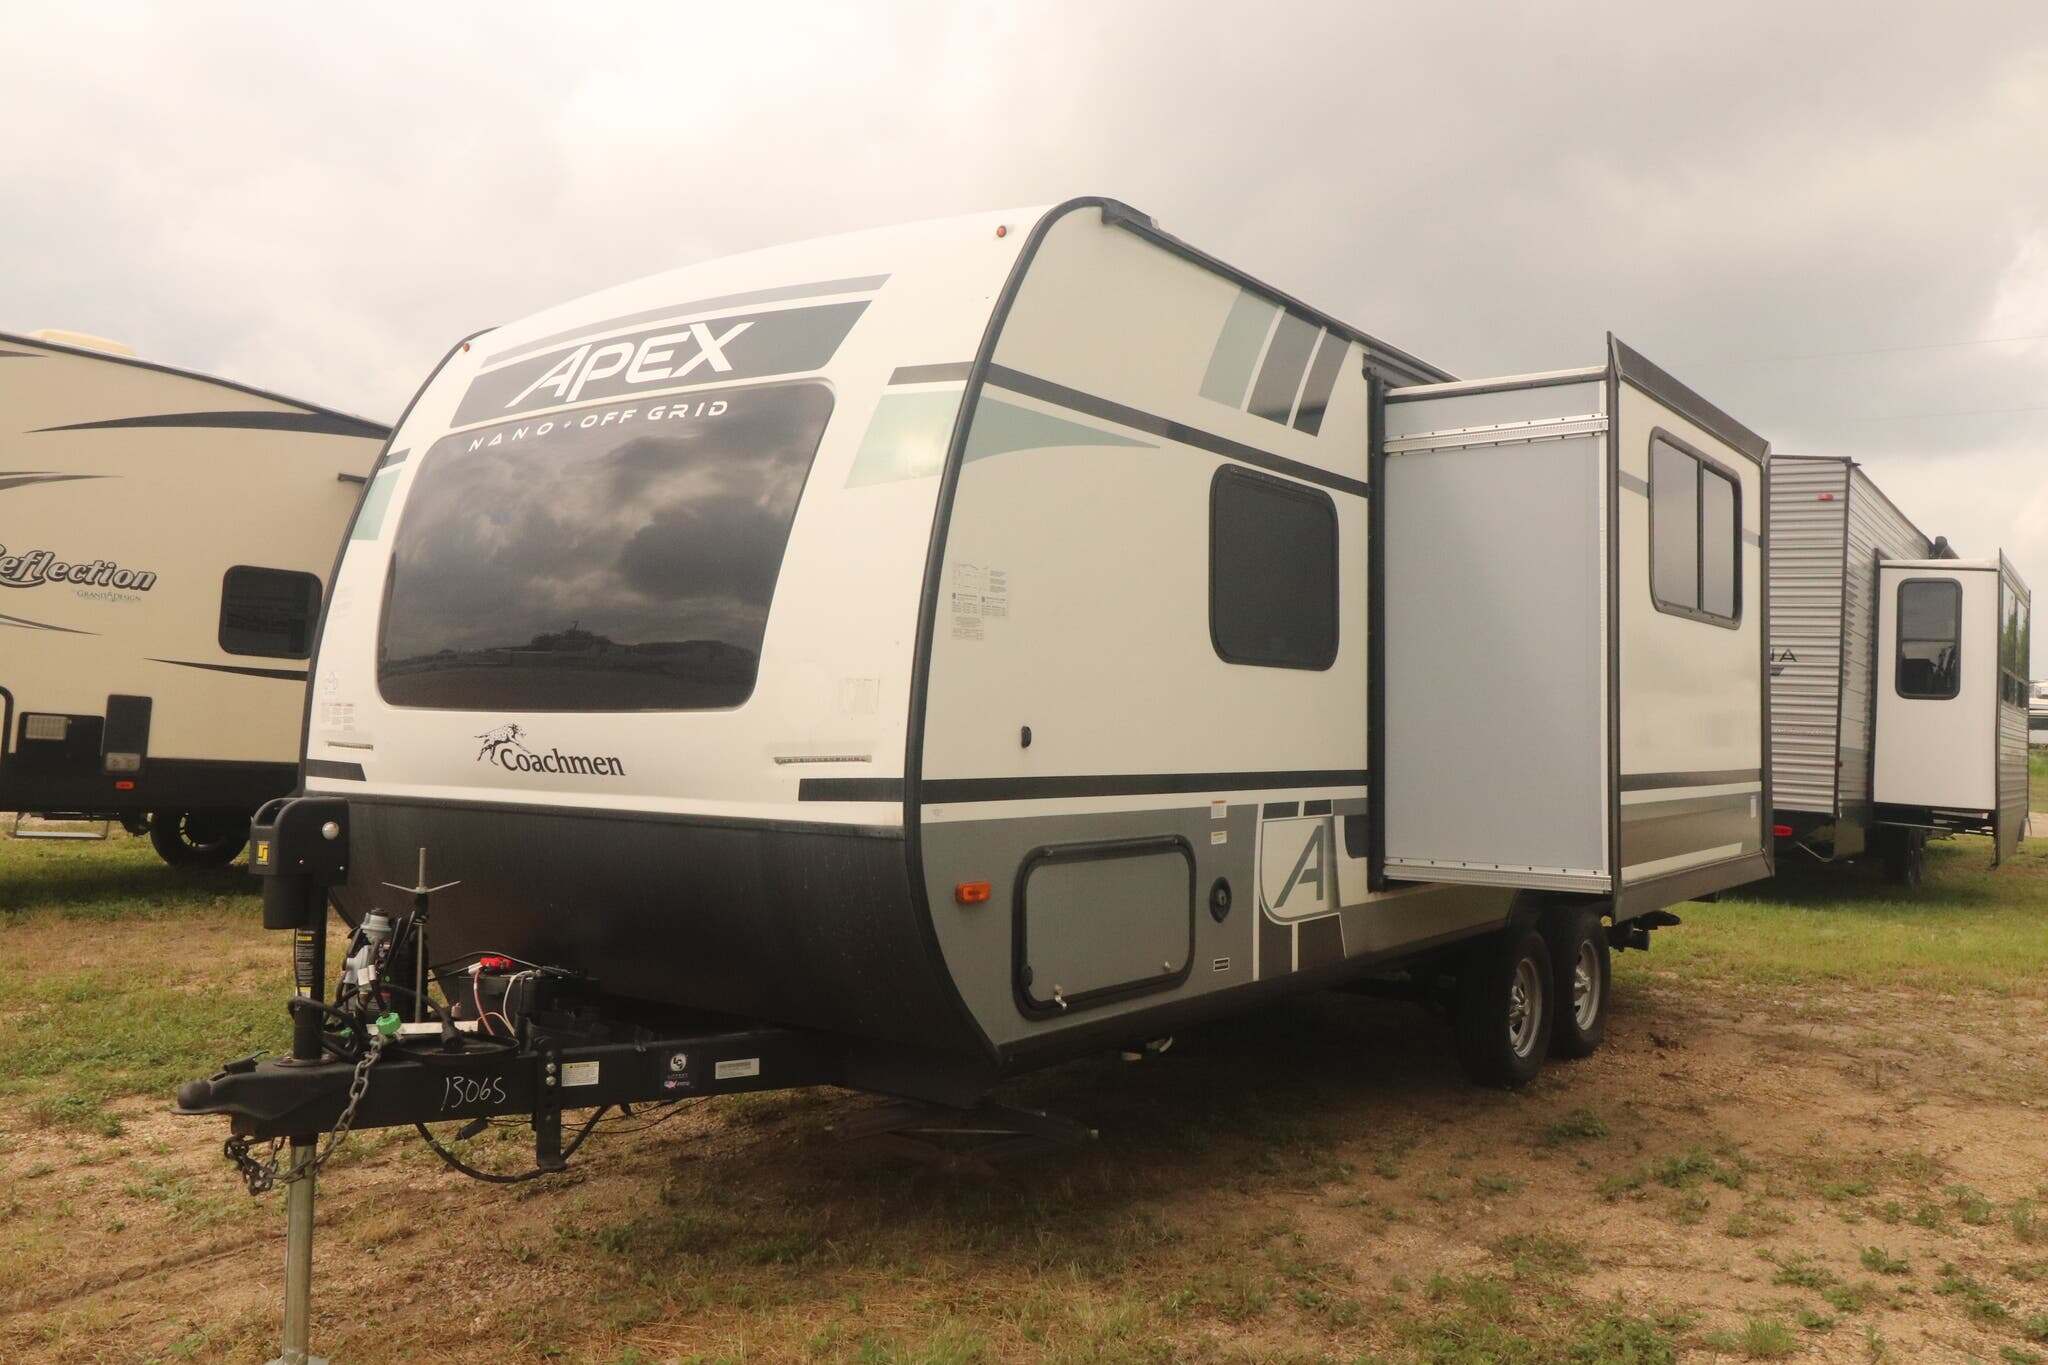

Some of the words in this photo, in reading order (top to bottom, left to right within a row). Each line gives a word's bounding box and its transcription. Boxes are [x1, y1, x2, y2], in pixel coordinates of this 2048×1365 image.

[504, 321, 755, 408] APEX
[647, 400, 728, 421] GRID
[0, 543, 157, 591] eflection
[500, 748, 626, 776] Coachmen
